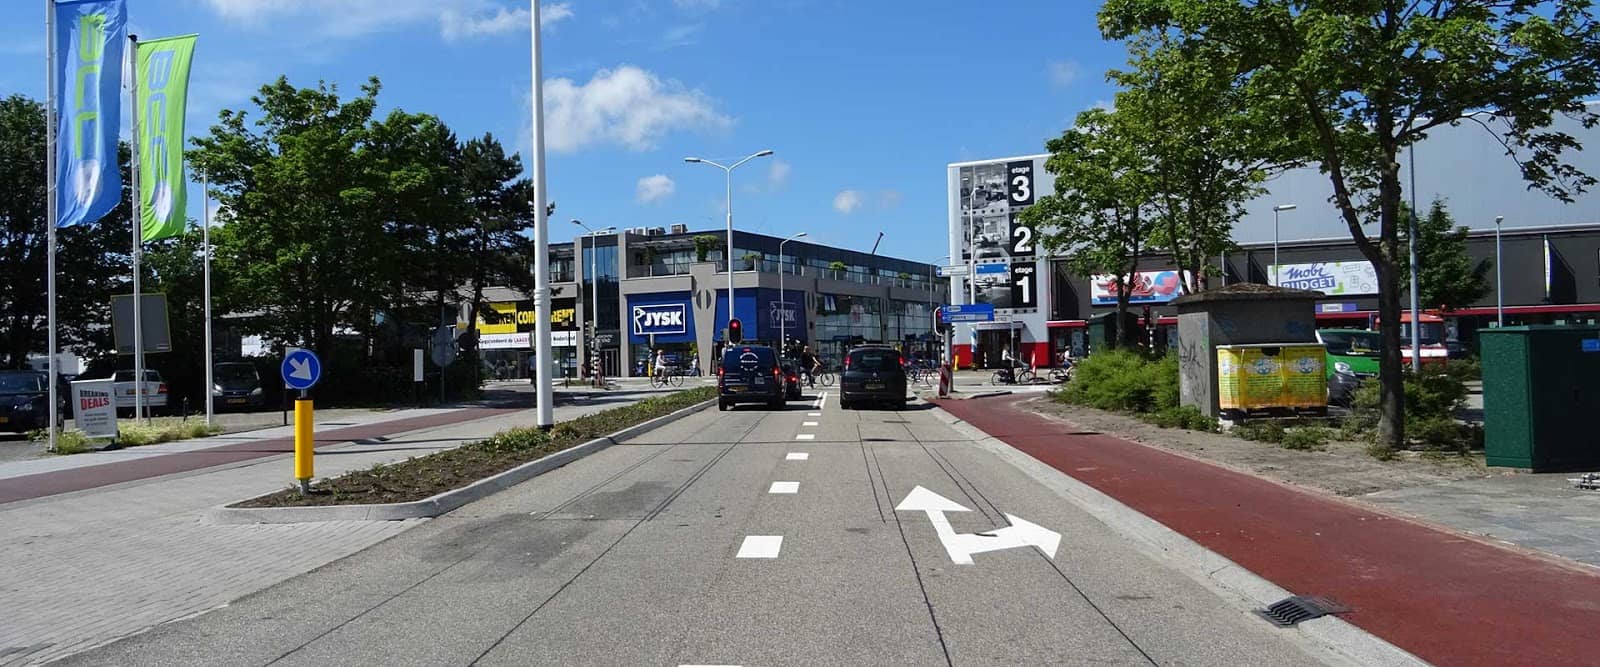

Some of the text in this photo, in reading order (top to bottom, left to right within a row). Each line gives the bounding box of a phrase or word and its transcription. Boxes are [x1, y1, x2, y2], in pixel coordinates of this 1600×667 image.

[147, 49, 176, 182] BCC
[1011, 166, 1030, 174] etage
[1012, 175, 1031, 202] 3
[1013, 226, 1032, 253] 2
[1014, 266, 1033, 275] etage
[1284, 262, 1331, 279] mobi
[1016, 275, 1030, 303] 1
[644, 311, 682, 327] JYSK
[80, 397, 110, 410] DEALS
